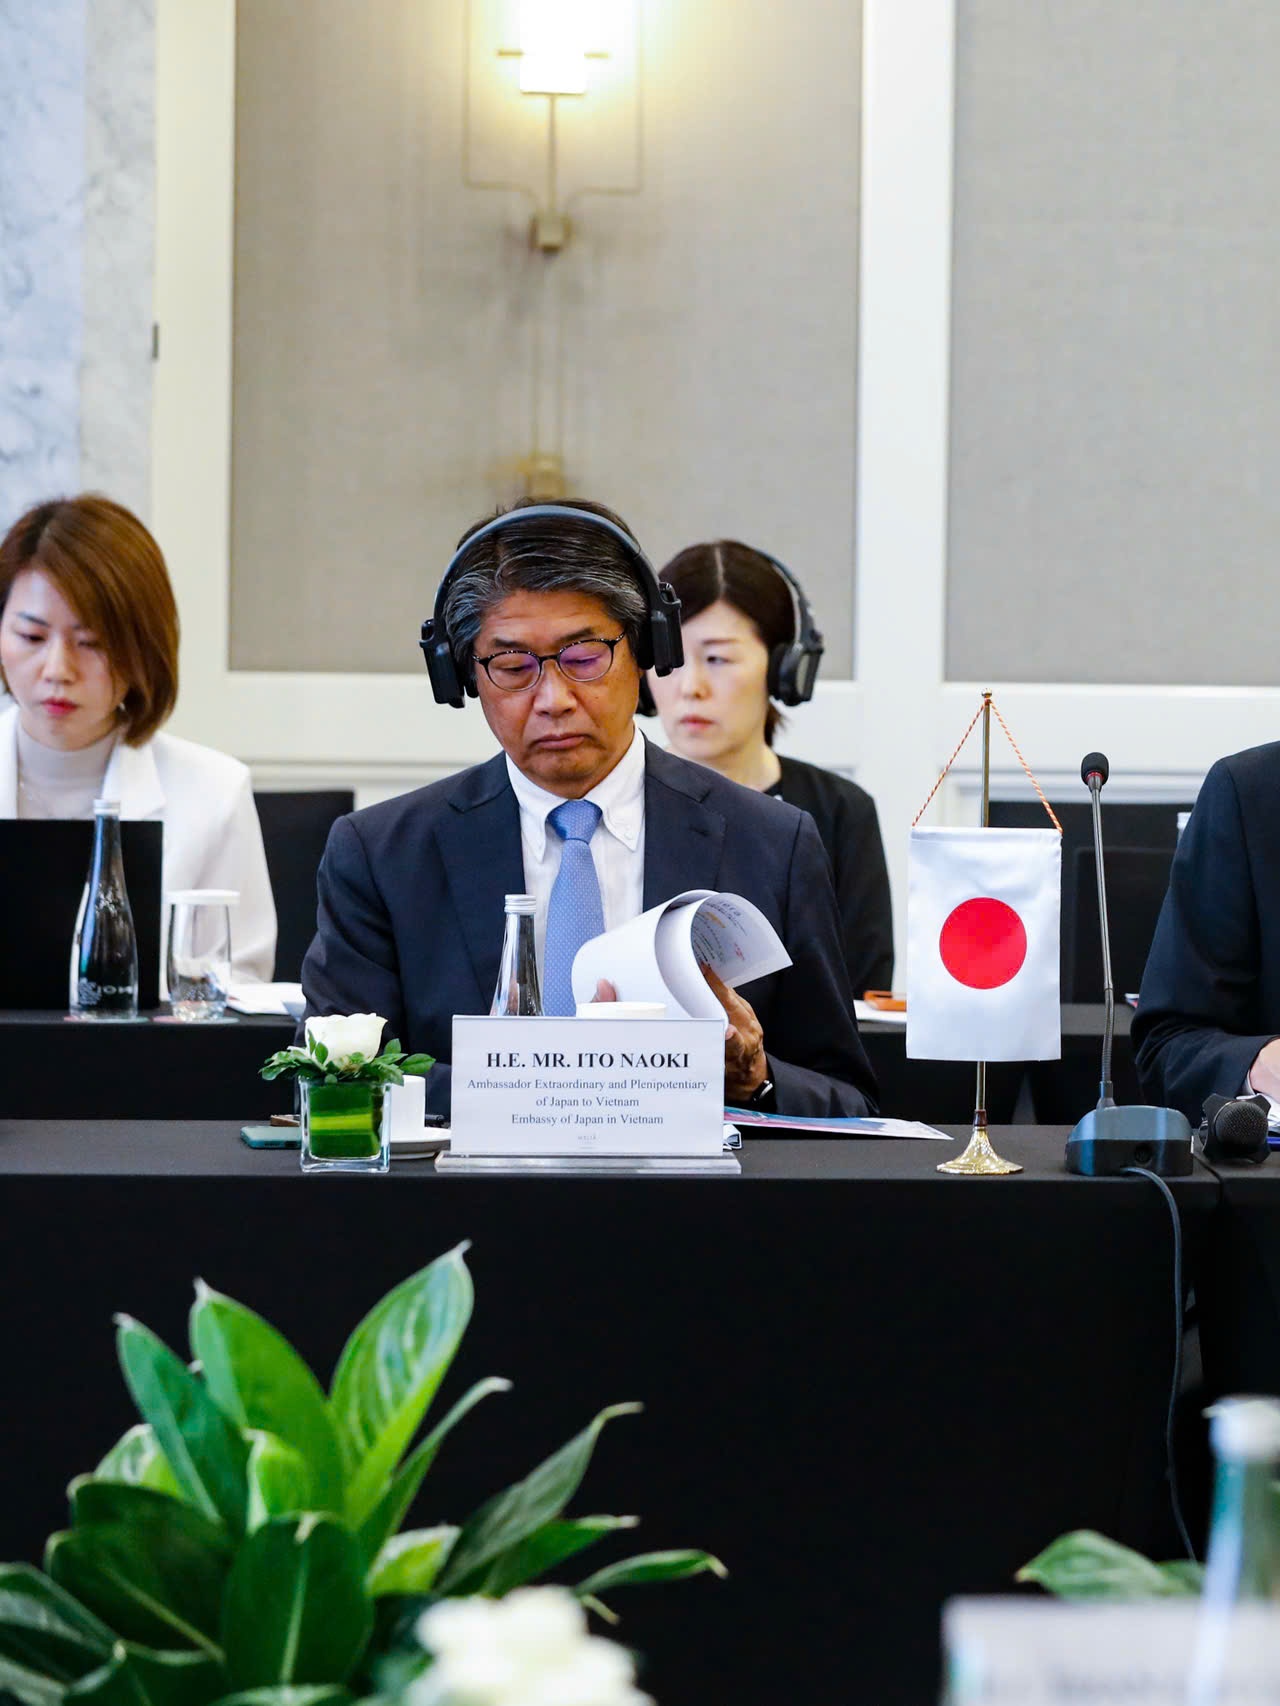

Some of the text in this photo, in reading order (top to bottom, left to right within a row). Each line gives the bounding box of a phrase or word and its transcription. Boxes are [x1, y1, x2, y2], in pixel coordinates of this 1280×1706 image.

[486, 1052, 689, 1069] H.E. MR. ITO NAOKI
[467, 1079, 708, 1092] Ambassador Extraordinary and Plenipotentiary
[535, 1096, 640, 1110] of Japan to Vietnam
[511, 1113, 664, 1127] Embassy of Japan in Vietnam
